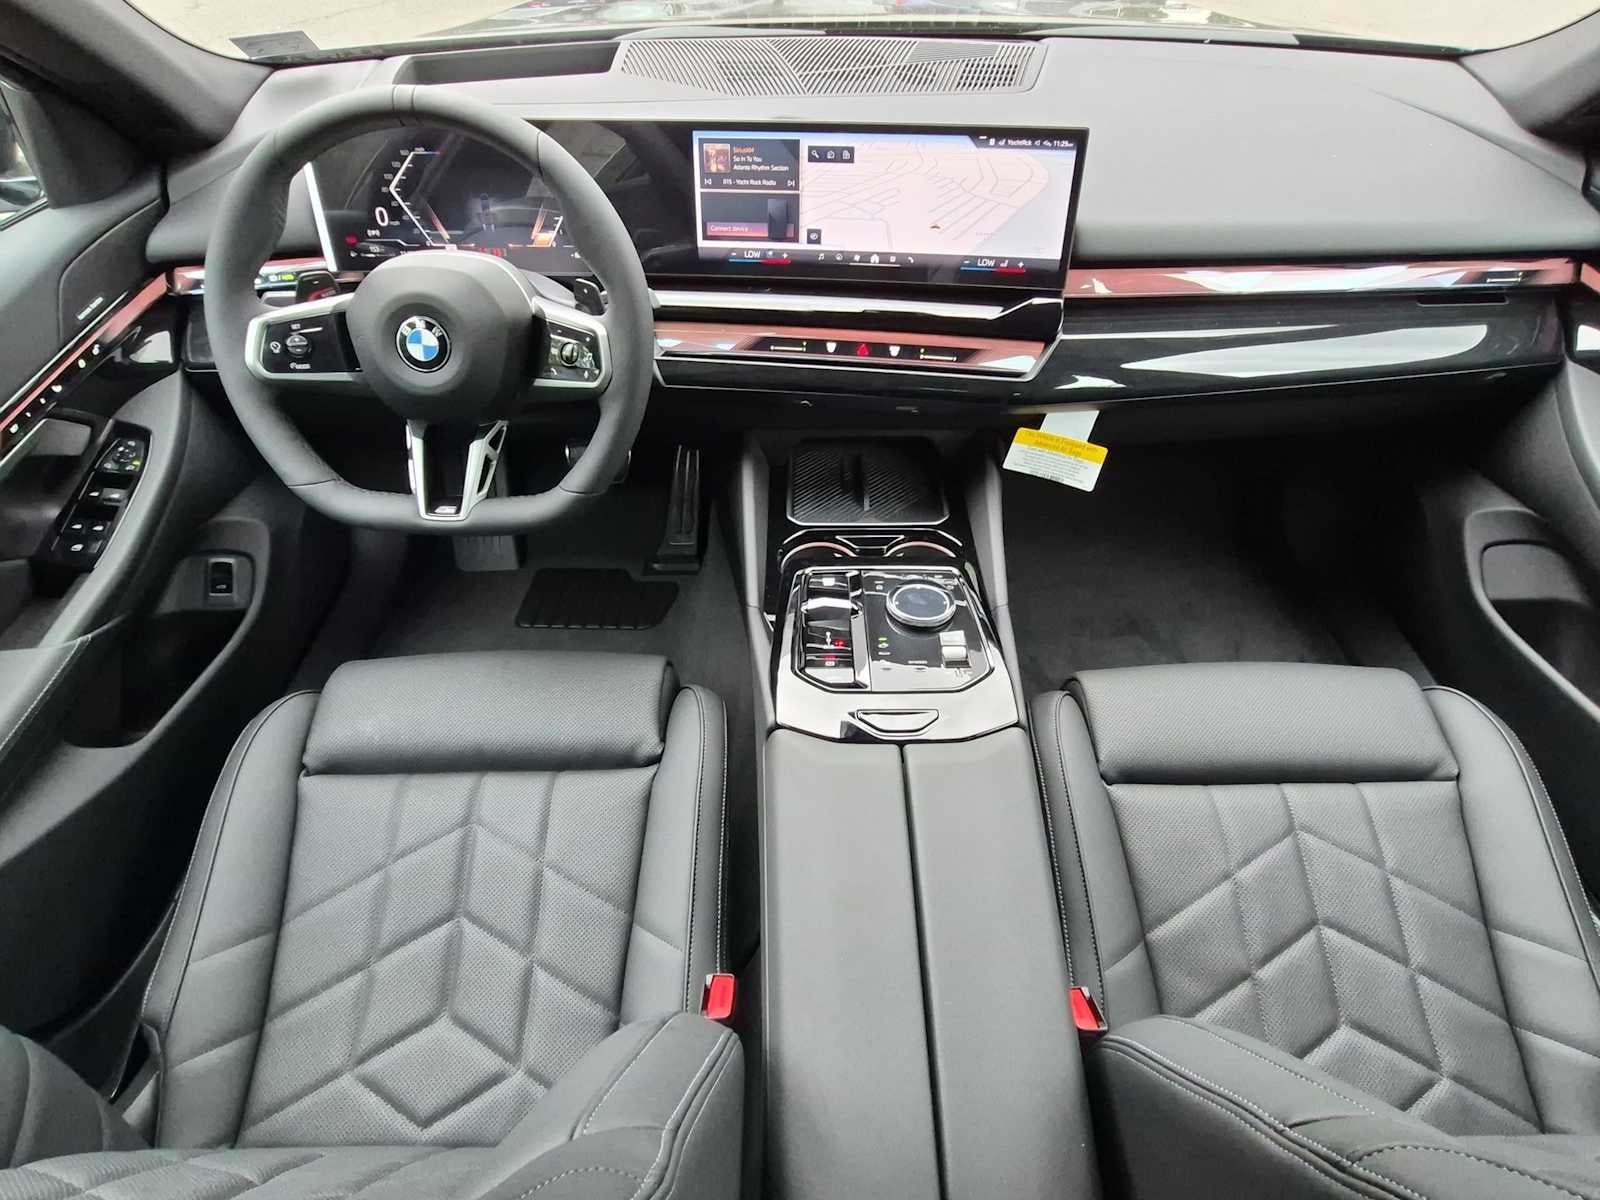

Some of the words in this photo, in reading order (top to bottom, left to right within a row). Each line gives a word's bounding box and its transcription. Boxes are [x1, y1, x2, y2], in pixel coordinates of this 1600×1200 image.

[375, 206, 389, 227] 0
[743, 250, 761, 259] LOW
[977, 258, 996, 267] LOW
[400, 319, 443, 338] BMW
